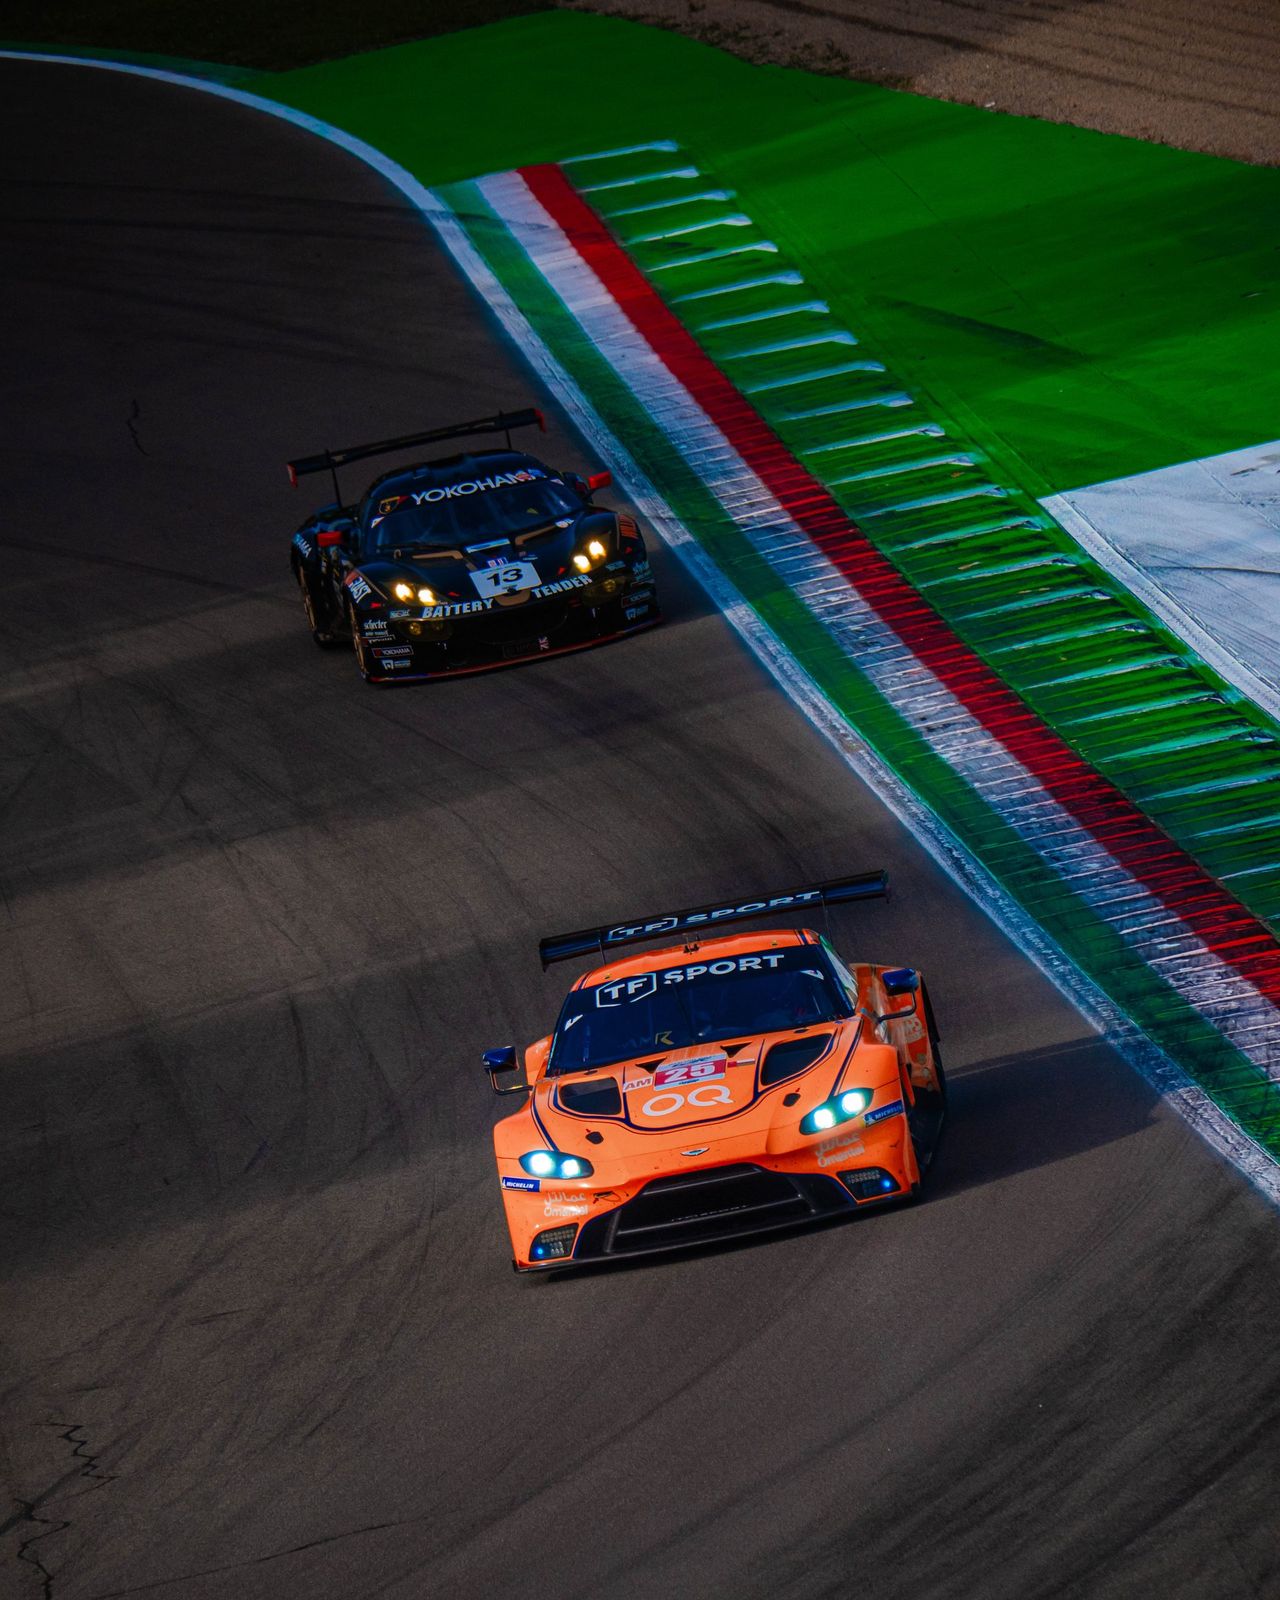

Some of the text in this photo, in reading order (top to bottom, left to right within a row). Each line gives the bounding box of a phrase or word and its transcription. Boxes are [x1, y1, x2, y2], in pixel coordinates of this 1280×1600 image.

[487, 568, 523, 586] 13
[422, 574, 593, 619] BATTERY TENDER
[618, 890, 821, 938] TF SPORT
[603, 954, 785, 1000] TF SPORT
[625, 1079, 652, 1091] AM
[664, 1062, 715, 1083] 25
[642, 1085, 734, 1117] OQ
[506, 1181, 535, 1189] MICHELIN
